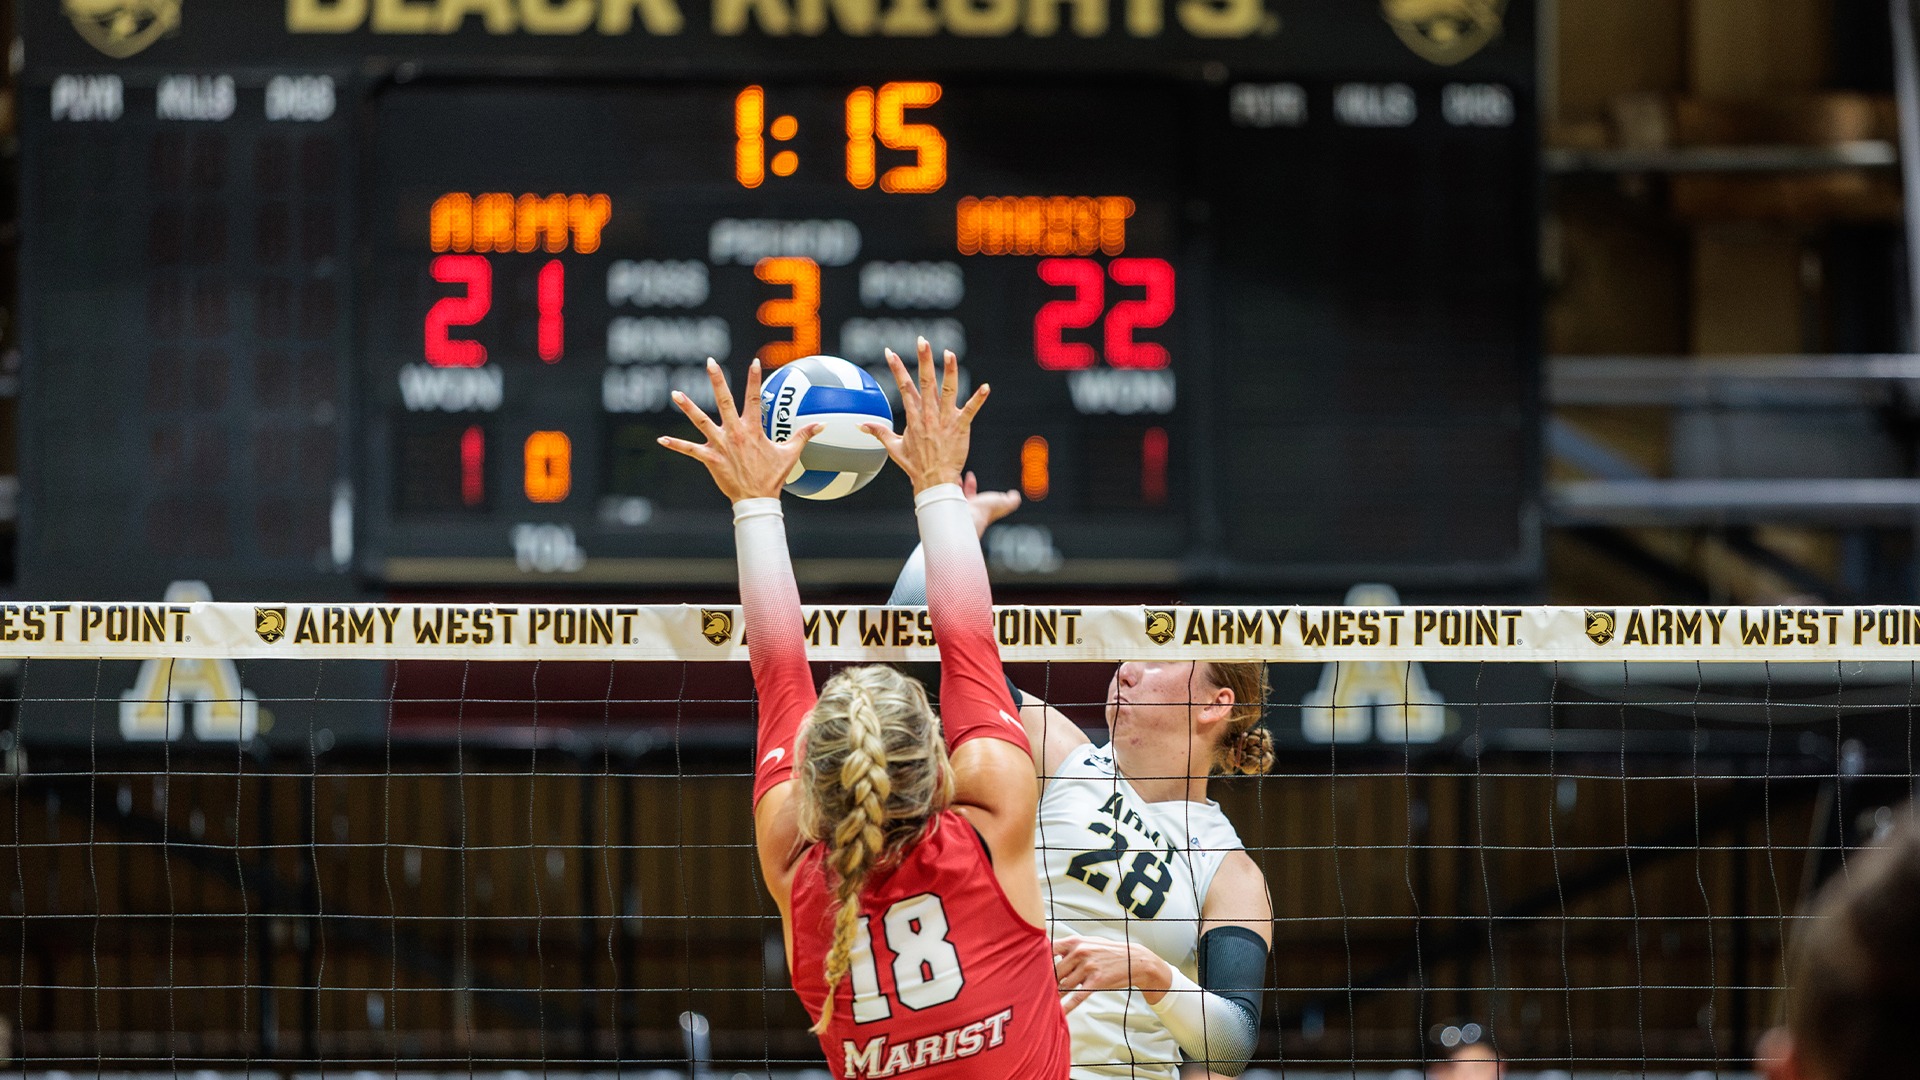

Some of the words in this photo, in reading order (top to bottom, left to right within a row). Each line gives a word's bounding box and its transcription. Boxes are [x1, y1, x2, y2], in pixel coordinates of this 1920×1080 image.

[430, 192, 611, 254] ARMY
[754, 257, 821, 368] 3
[1034, 258, 1175, 370] 22
[80, 606, 191, 643] POINT
[293, 607, 402, 645] ARMY
[413, 607, 519, 645] WEST
[528, 608, 639, 645] POINT
[859, 609, 938, 647] WES
[993, 609, 1083, 646] OINT
[1183, 609, 1290, 646] ARMY
[1301, 609, 1405, 647] WEST
[1413, 609, 1523, 647] POINT
[1623, 608, 1729, 646] ARMY
[1740, 609, 1844, 646] WEST
[1065, 821, 1174, 920] 28
[850, 891, 966, 1026] 18
[843, 1005, 1013, 1080] MARIST
